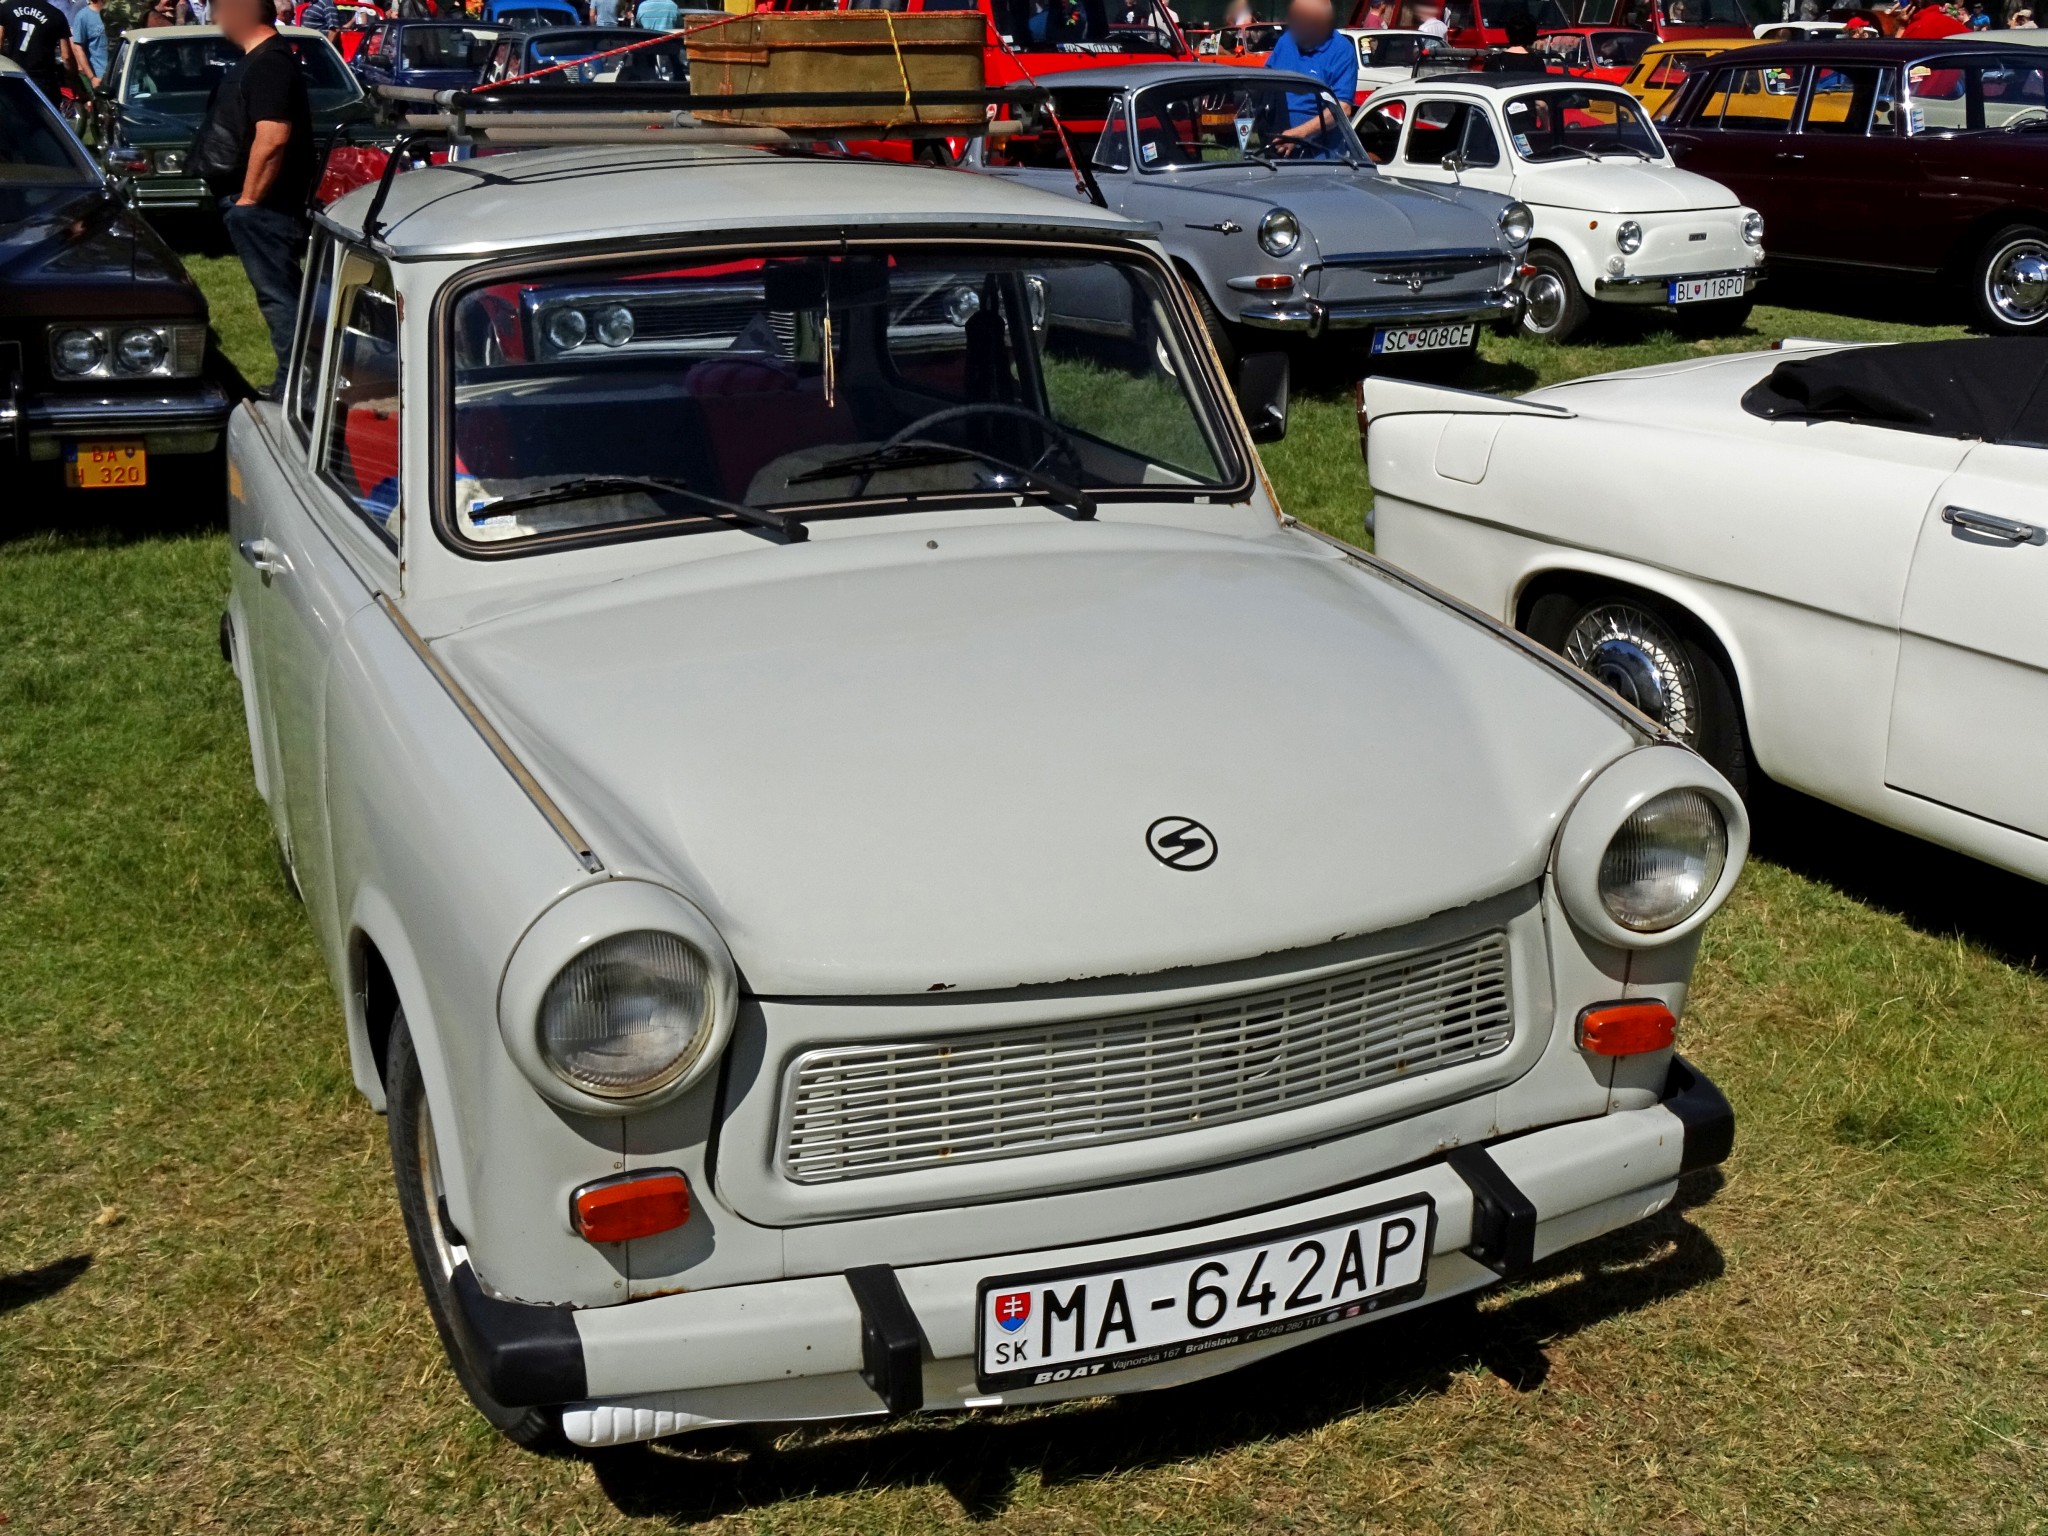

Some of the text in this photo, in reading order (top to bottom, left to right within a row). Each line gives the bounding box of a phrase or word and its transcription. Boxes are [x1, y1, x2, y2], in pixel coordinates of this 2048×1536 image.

[20, 22, 35, 52] 7
[1678, 283, 1694, 301] BL
[1385, 331, 1408, 351] SC
[1416, 325, 1472, 348] 908CE
[92, 446, 118, 463] BA
[101, 466, 139, 484] 320
[1041, 1217, 1416, 1358] MA-642AP
[996, 1339, 1028, 1365] SK
[1033, 1363, 1105, 1385] BOAT
[1162, 1347, 1181, 1359] 167
[1185, 1334, 1239, 1354] Bratislava
